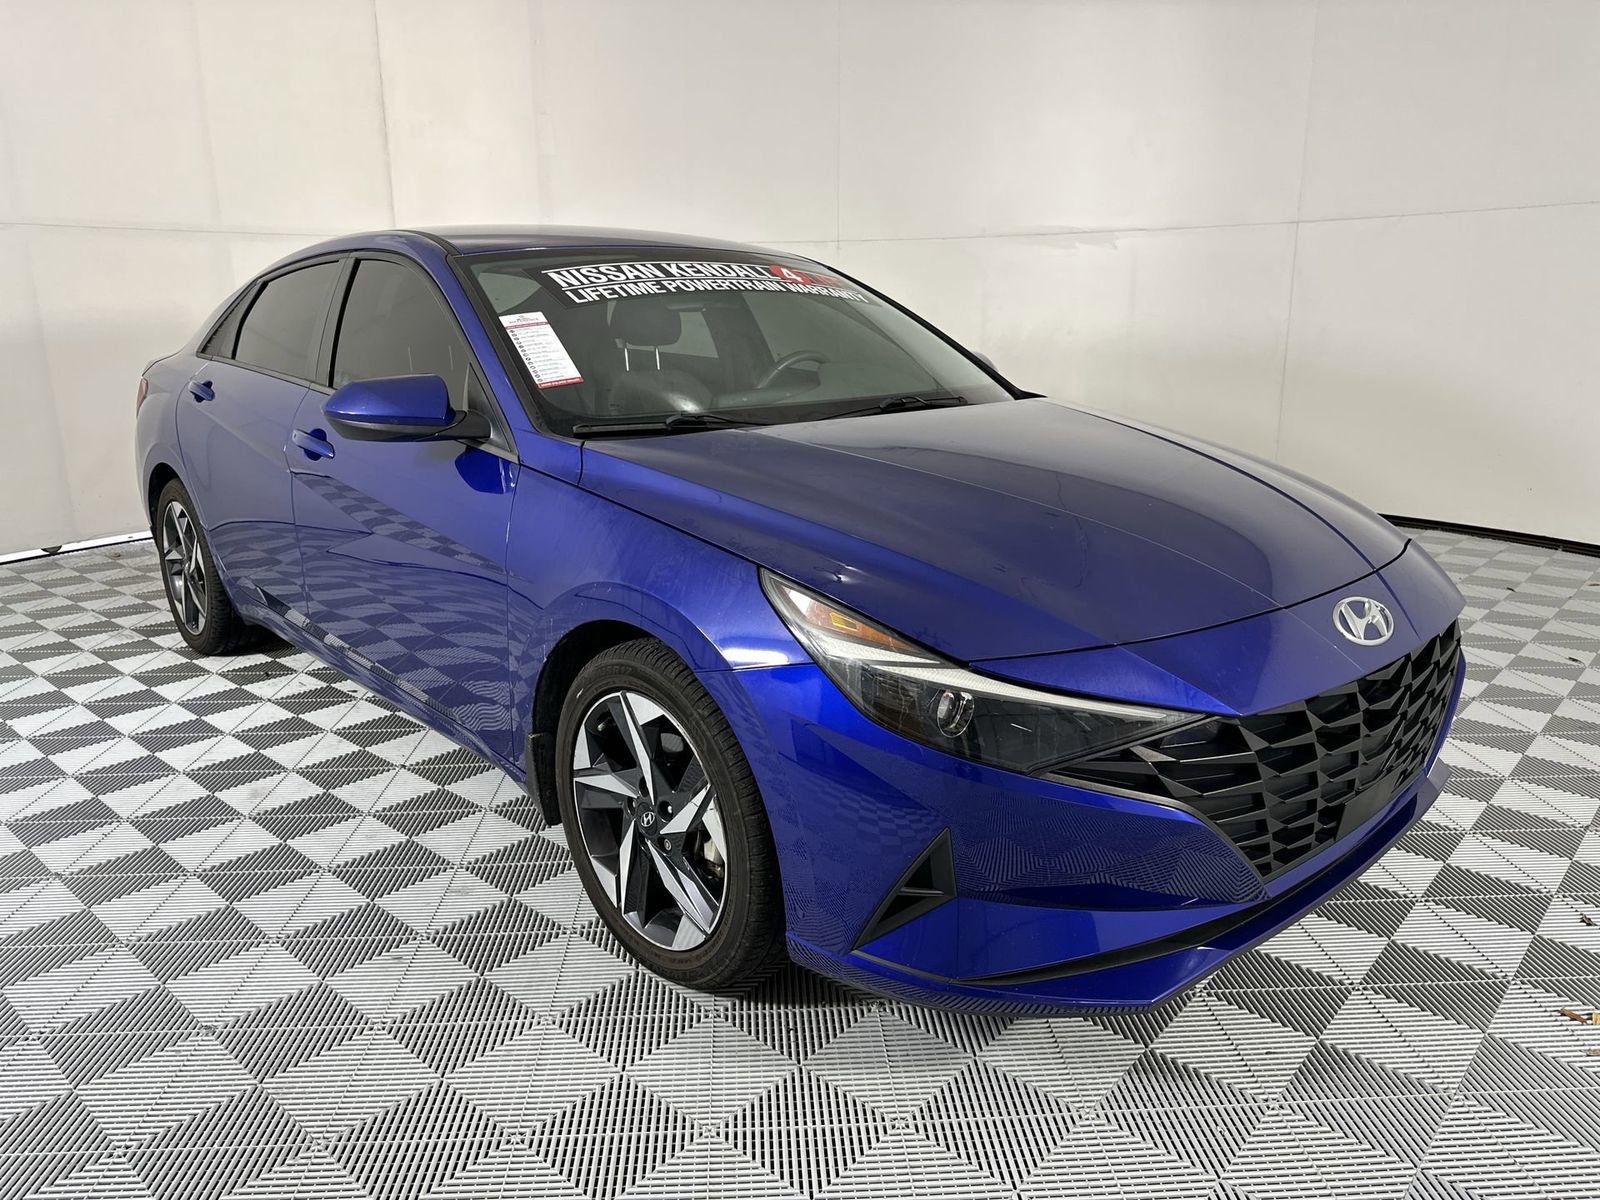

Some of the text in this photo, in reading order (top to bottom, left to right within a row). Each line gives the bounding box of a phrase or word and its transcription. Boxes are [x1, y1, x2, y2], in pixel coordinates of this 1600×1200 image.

[547, 263, 666, 288] NISSAN
[661, 262, 782, 280] KENDALL
[780, 267, 804, 283] 4
[565, 281, 667, 304] LIFETIME
[661, 279, 787, 292] POWERTRAIN
[784, 282, 869, 304] WARRANTY
